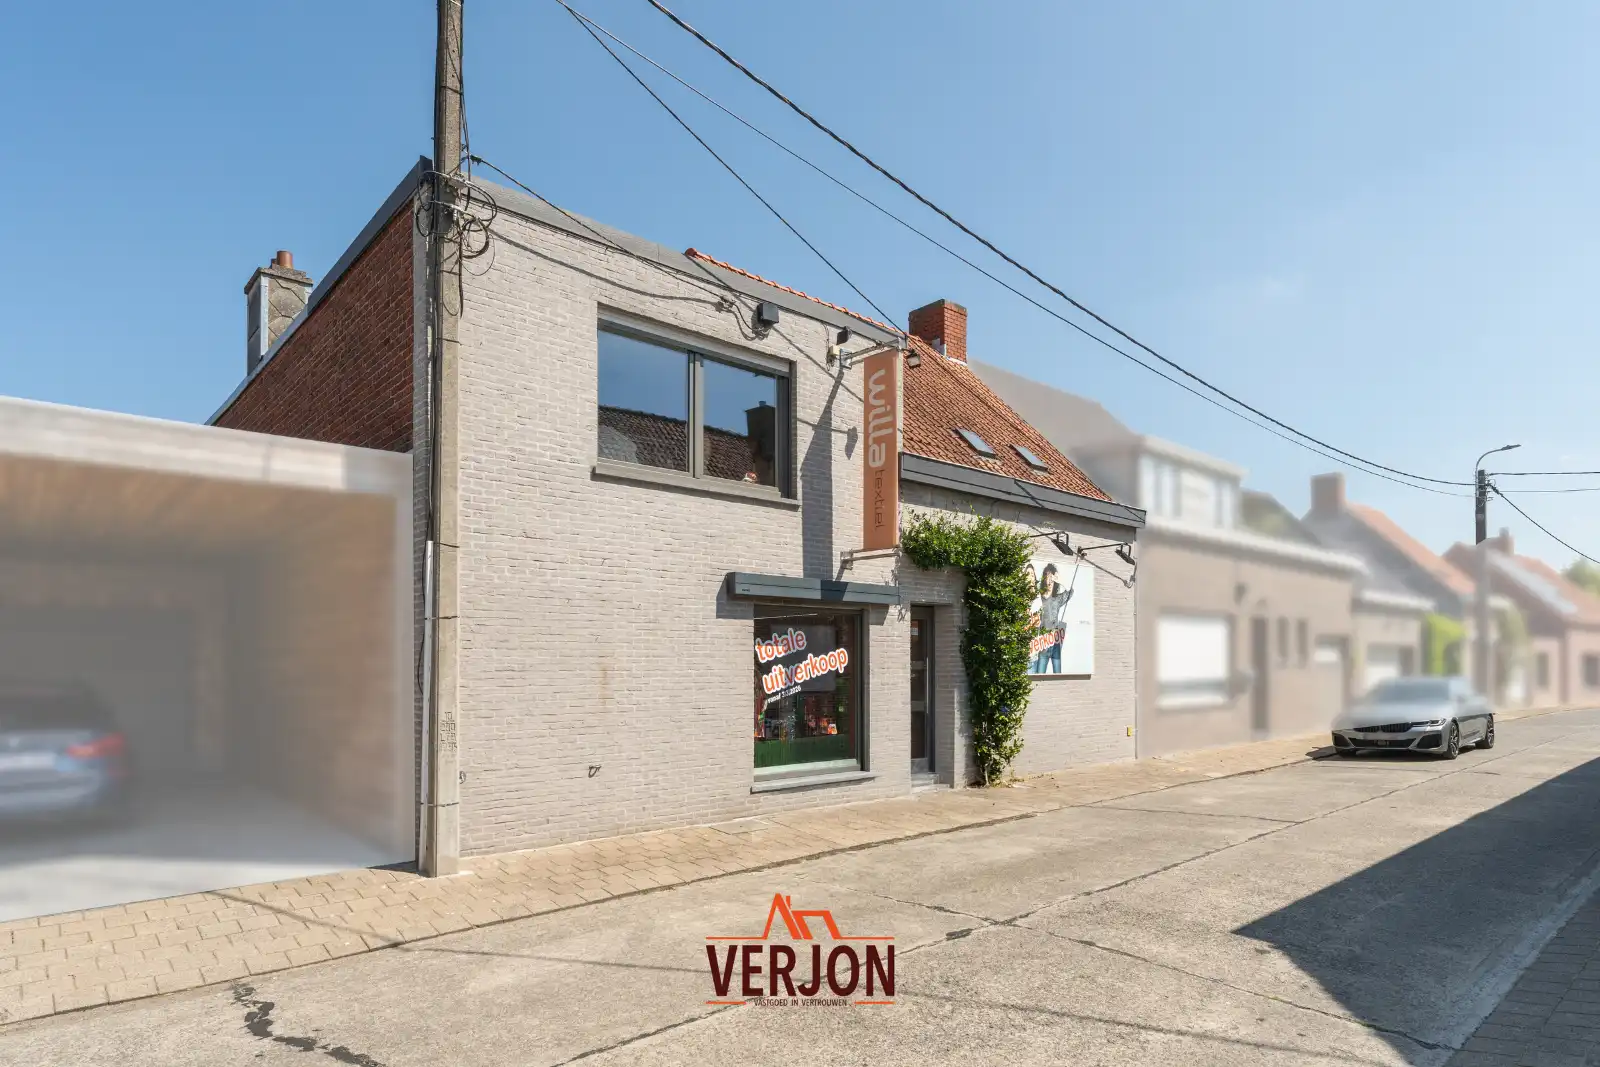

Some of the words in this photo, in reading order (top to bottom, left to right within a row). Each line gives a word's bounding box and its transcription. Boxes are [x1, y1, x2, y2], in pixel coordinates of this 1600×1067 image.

[868, 369, 894, 468] willa
[874, 468, 886, 529] textiel
[755, 628, 807, 663] totale
[762, 648, 849, 694] uitverkoop
